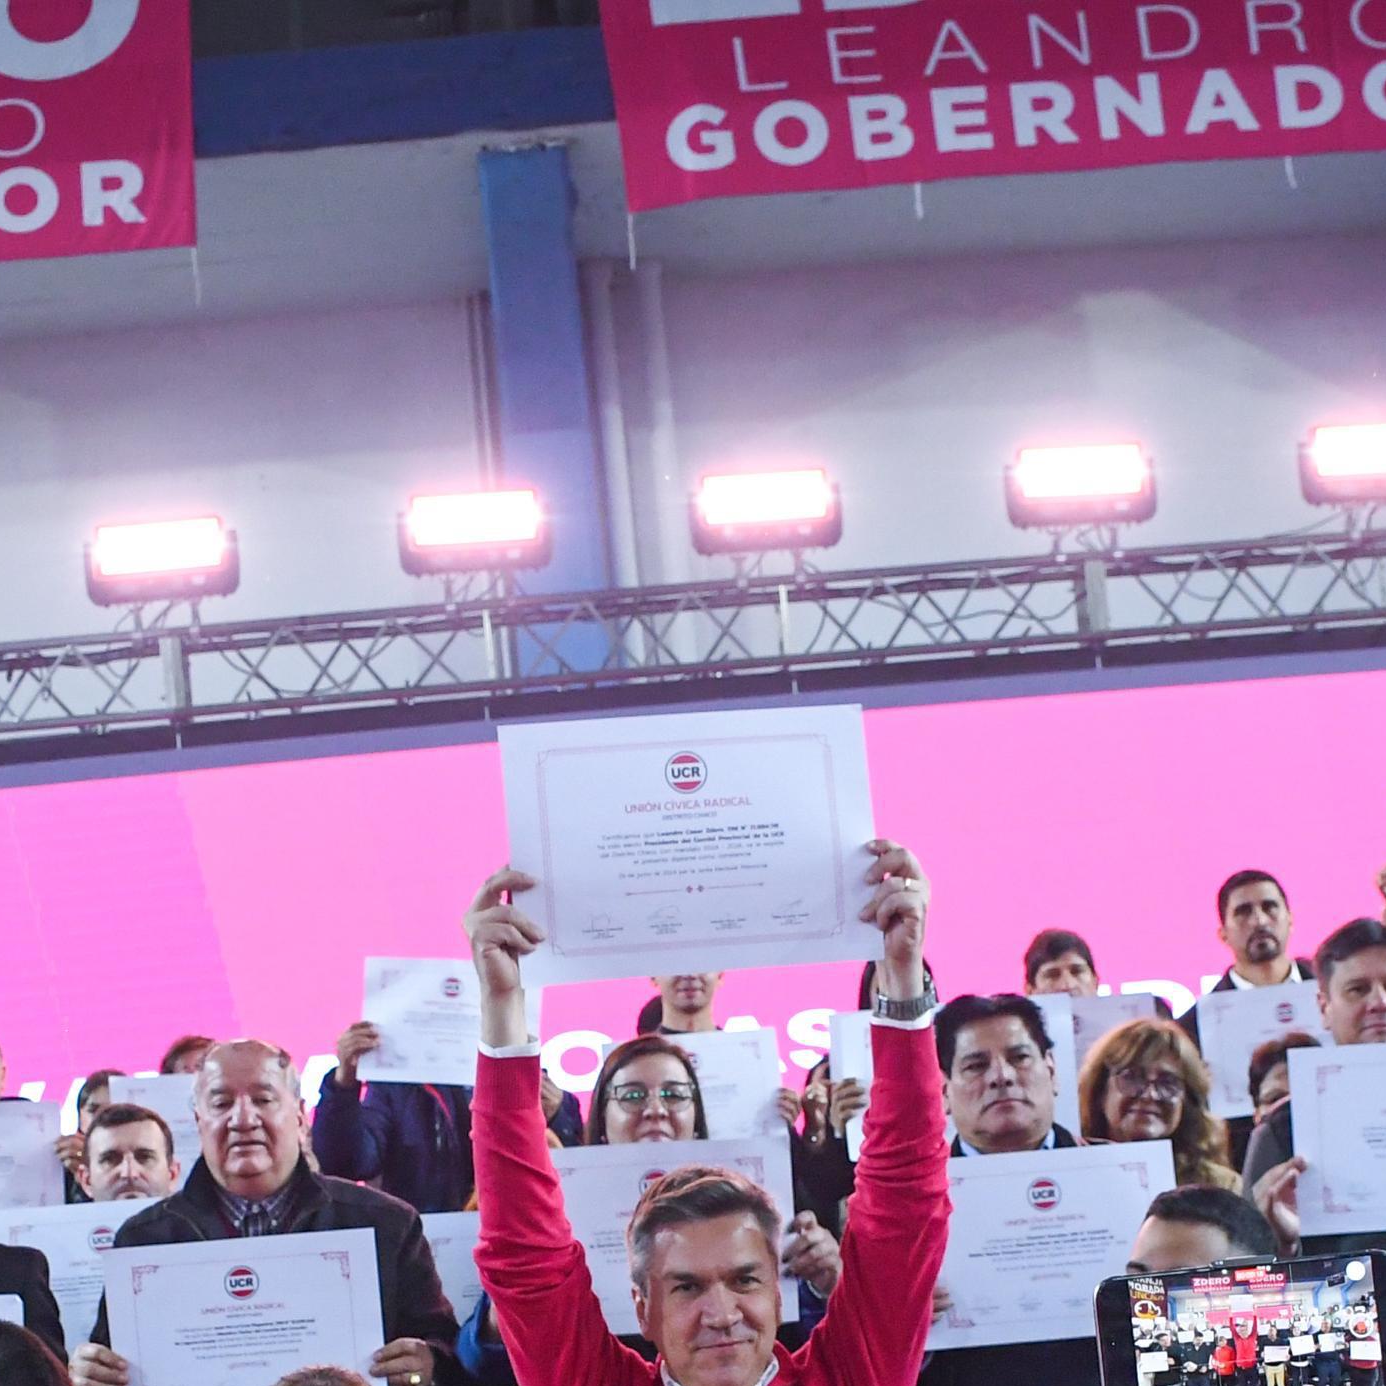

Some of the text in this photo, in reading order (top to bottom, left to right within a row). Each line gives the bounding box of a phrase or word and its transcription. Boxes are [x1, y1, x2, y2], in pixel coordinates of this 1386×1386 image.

[671, 766, 700, 779] UCR
[624, 796, 752, 814] UNIÓN CÍVICA RADICAL
[1032, 1189, 1055, 1199] UCR
[229, 1278, 253, 1288] UCR
